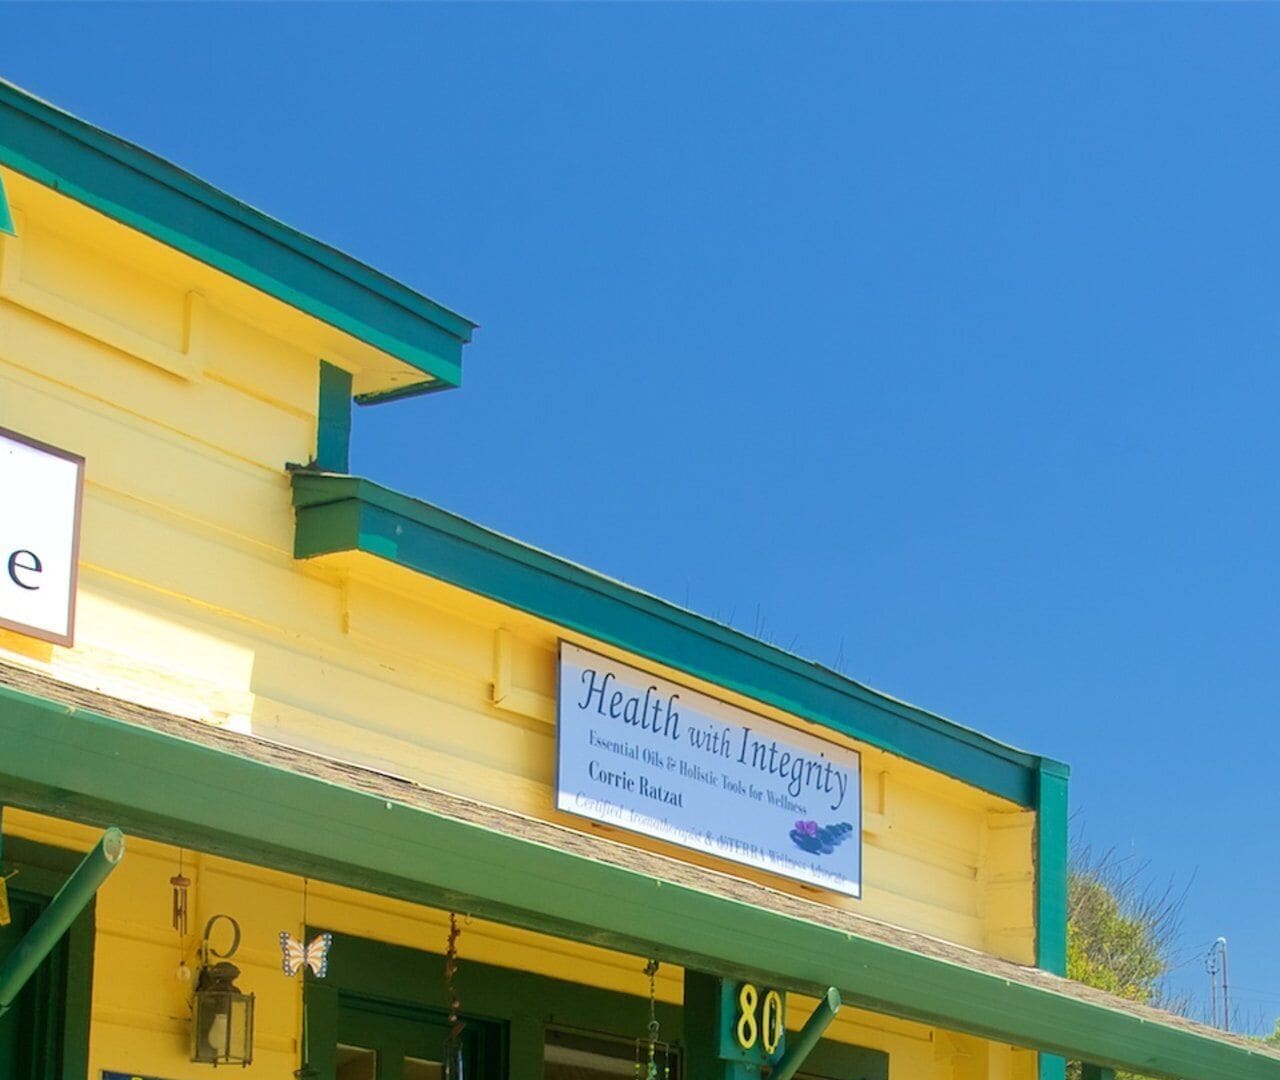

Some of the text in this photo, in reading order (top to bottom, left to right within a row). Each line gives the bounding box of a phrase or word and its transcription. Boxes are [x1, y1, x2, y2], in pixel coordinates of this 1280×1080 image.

[577, 668, 849, 812] Health with Integrity
[589, 728, 808, 817] Essential Oils & Holistic Tools for Wellness
[588, 759, 684, 808] Corrie Ratzat
[738, 984, 782, 1054] 80
